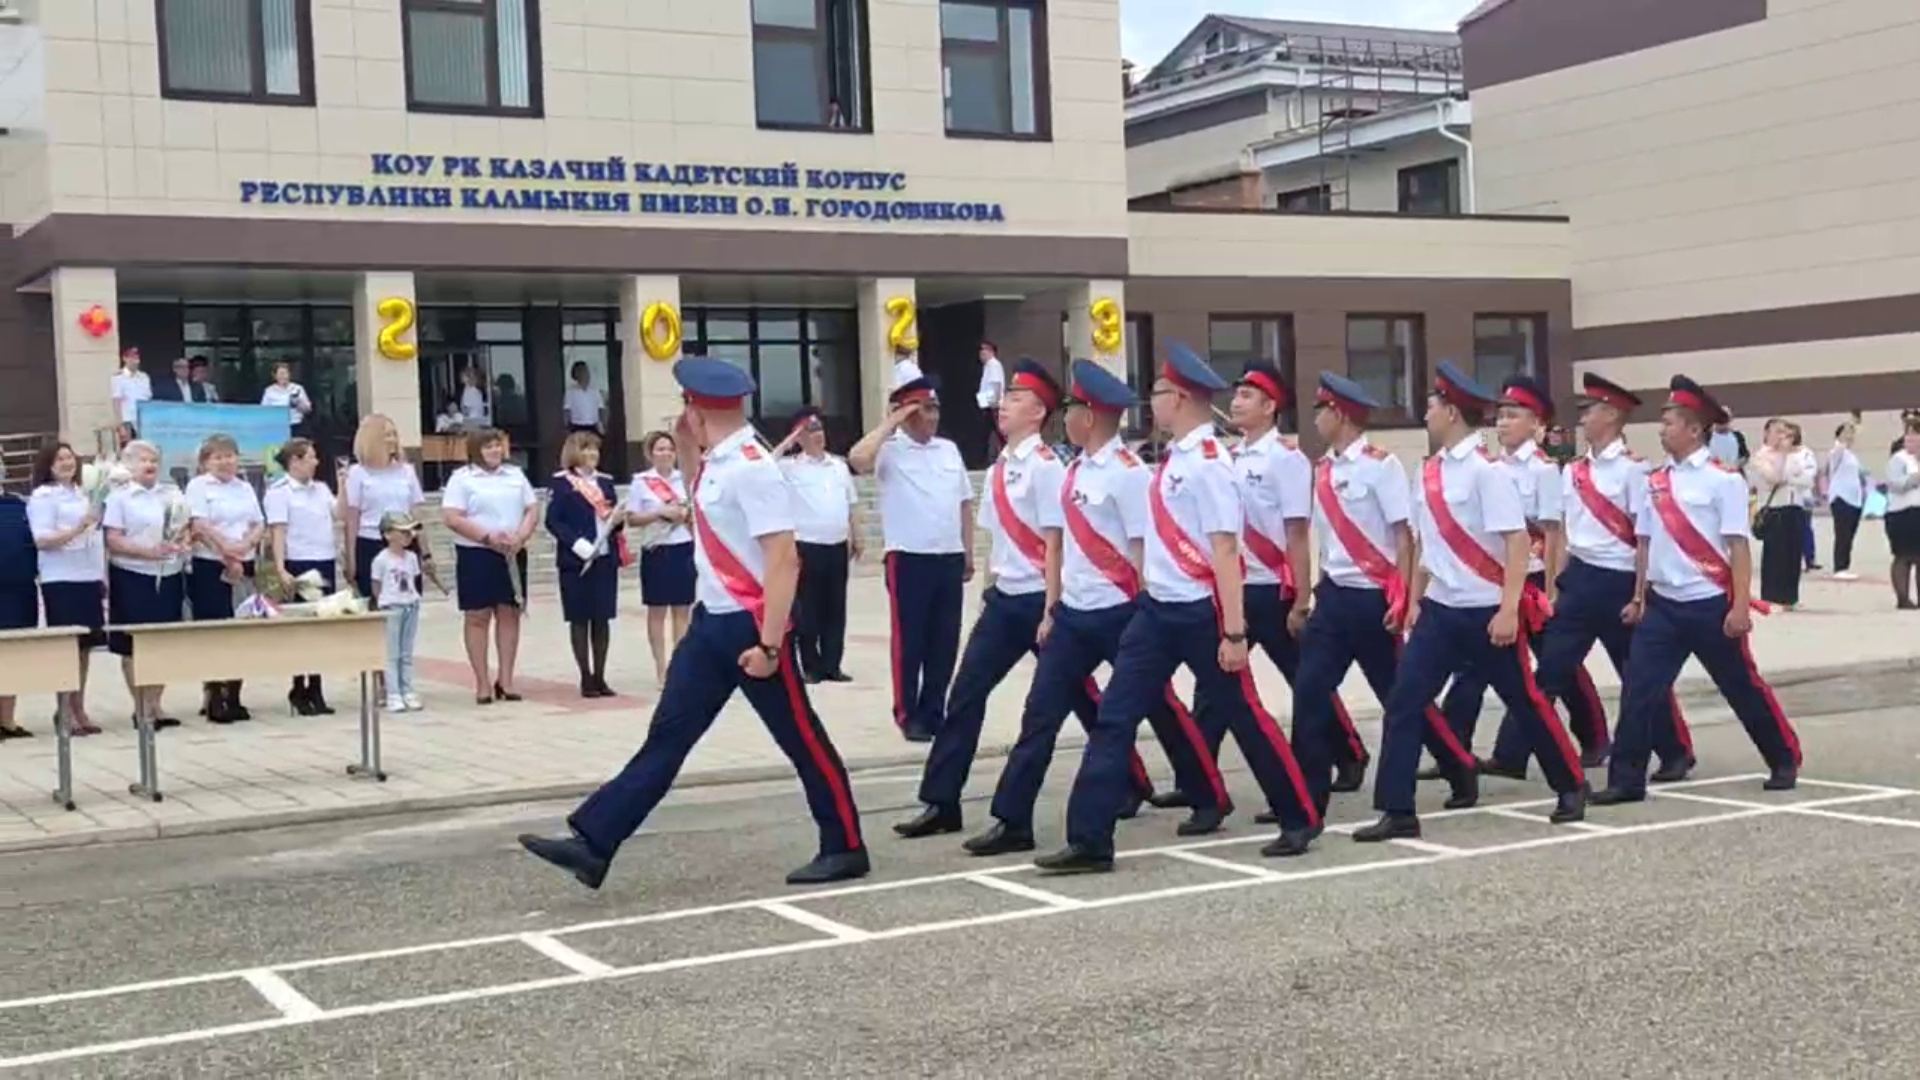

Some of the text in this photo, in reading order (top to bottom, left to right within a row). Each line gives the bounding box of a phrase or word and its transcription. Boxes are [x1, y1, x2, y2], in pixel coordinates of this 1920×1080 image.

[372, 154, 906, 191] КОУ РК КАЗАЧИЙ КАДЕТСКИЙ КОРПУС
[240, 181, 452, 208] РЕСПУБЛИКИ
[461, 187, 630, 212] КАЛМЫКИЯ
[639, 194, 738, 215] ИМЕНИ
[806, 198, 1005, 223] ГОРОДОВИКОВА
